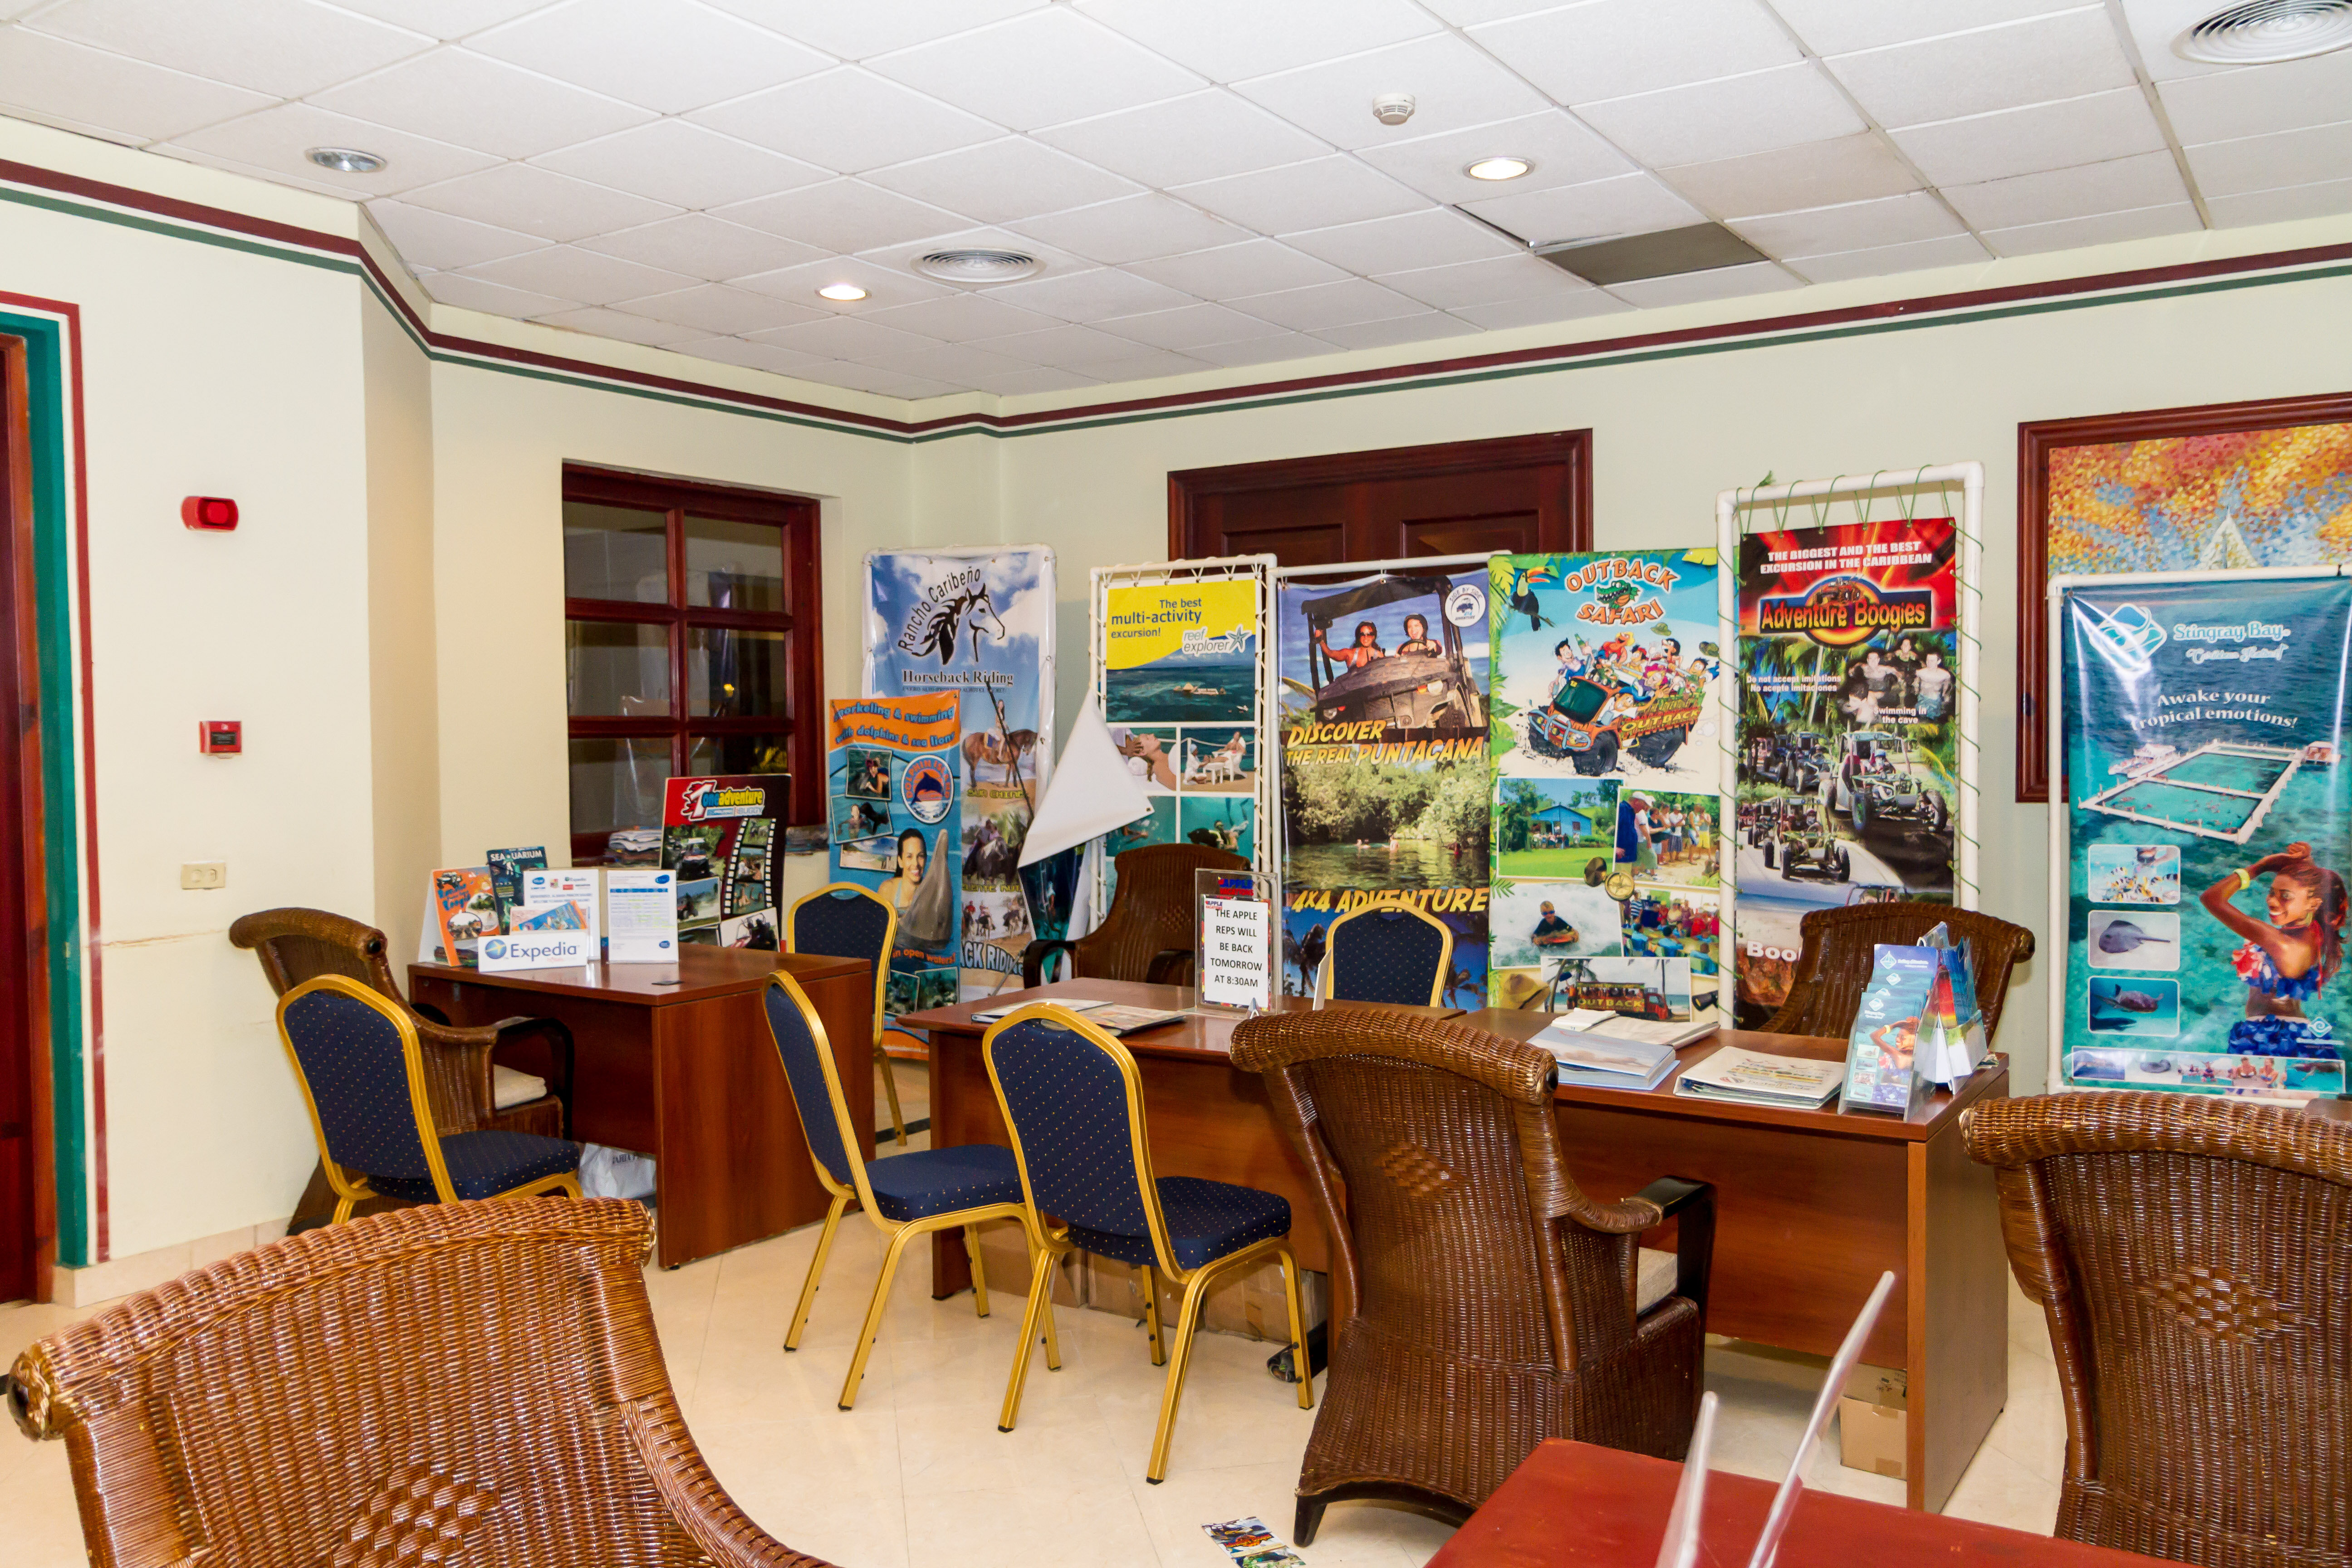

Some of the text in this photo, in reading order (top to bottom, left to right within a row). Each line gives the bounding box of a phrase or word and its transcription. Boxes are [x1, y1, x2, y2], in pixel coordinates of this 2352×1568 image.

[1768, 541, 1922, 562] THE BIGGEST AND THE BEST
[1760, 553, 1932, 574] EXCURSION IN THE CARIBBEAN
[1566, 559, 1680, 592] OUTBACK
[897, 566, 981, 652] Rancho Caribeño
[1160, 598, 1202, 609] The best
[1577, 598, 1664, 625] SAFARI
[1111, 609, 1202, 624] multi-activity
[1762, 597, 1926, 632] Adventure Boogies
[1111, 627, 1161, 639] excursion!
[1184, 628, 1206, 641] reef
[2174, 621, 2283, 642] Stingray Bay
[1184, 640, 1230, 654] explorer
[902, 671, 1014, 686] Horseback Riding
[1773, 675, 1800, 684] accept
[1750, 684, 1761, 692] No
[1791, 683, 1838, 692] imitacones
[2158, 689, 2272, 707] Awake your
[904, 706, 955, 724] swimming
[1622, 710, 1700, 732] OUTBACK
[1882, 715, 1896, 724] the
[2205, 708, 2298, 729] emotions!
[856, 725, 899, 742] dolphins
[1287, 720, 1387, 749] DISCOVER
[1286, 750, 1310, 766] THE
[1315, 747, 1351, 765] REAL
[1216, 909, 1257, 920] THE APPLE
[1216, 925, 1257, 937] REPS WILL
[511, 941, 577, 962] Expedia
[903, 948, 925, 959] open
[1220, 942, 1253, 953] BE BACK
[1746, 940, 1802, 962] Boo
[1210, 958, 1262, 971] TOMORROW
[1215, 975, 1258, 987] AT 8:30AM
